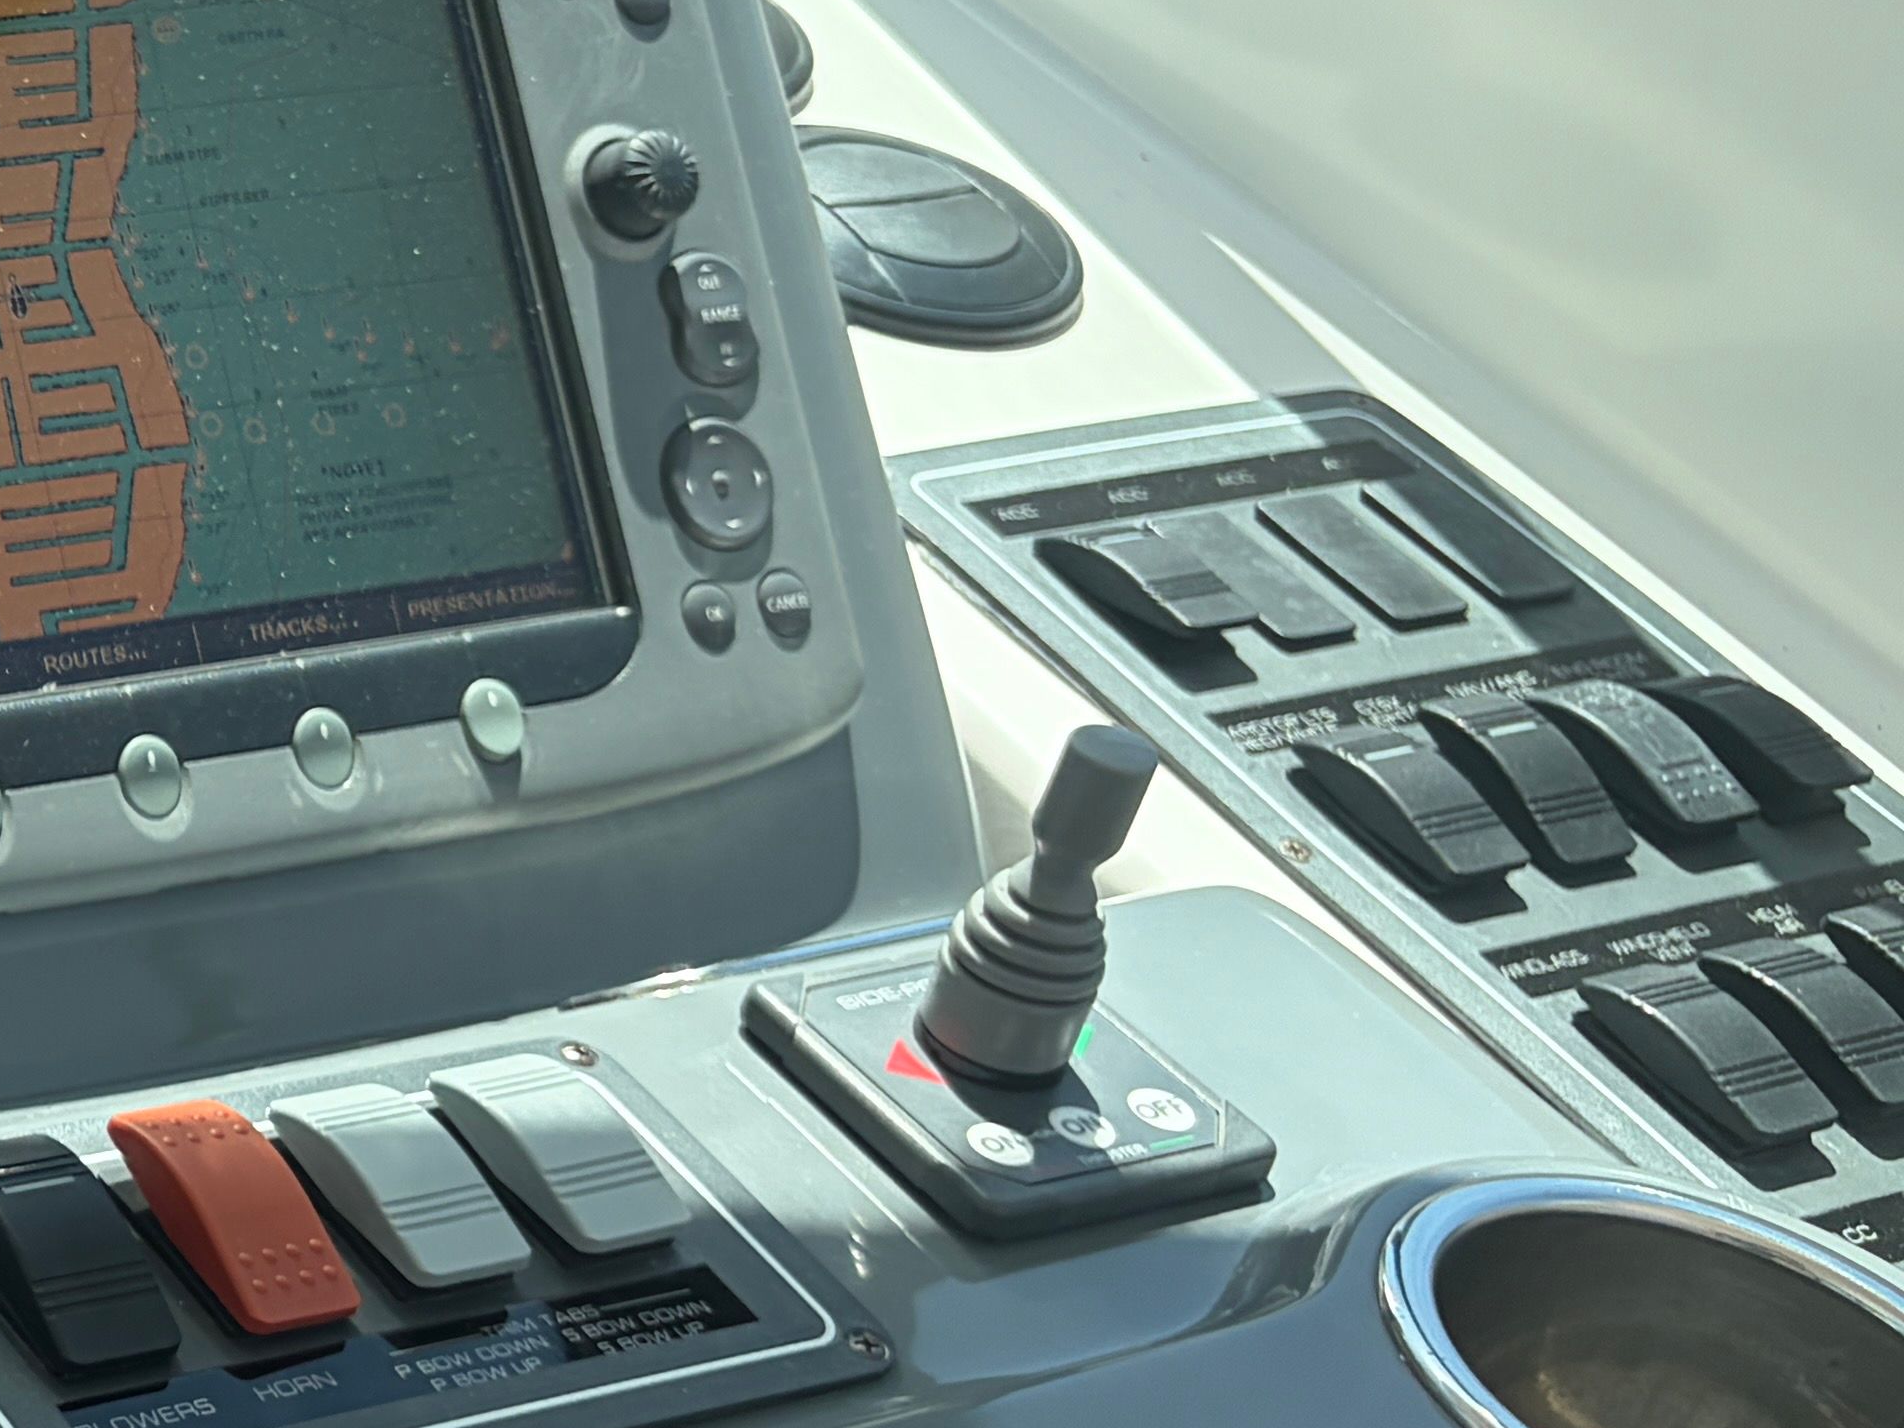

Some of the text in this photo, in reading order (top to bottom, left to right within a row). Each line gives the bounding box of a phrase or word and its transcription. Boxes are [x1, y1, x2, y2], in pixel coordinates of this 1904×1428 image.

[1136, 1095, 1183, 1120] OFF
[475, 1336, 551, 1362] DOWN
[253, 1371, 339, 1402] HORN
